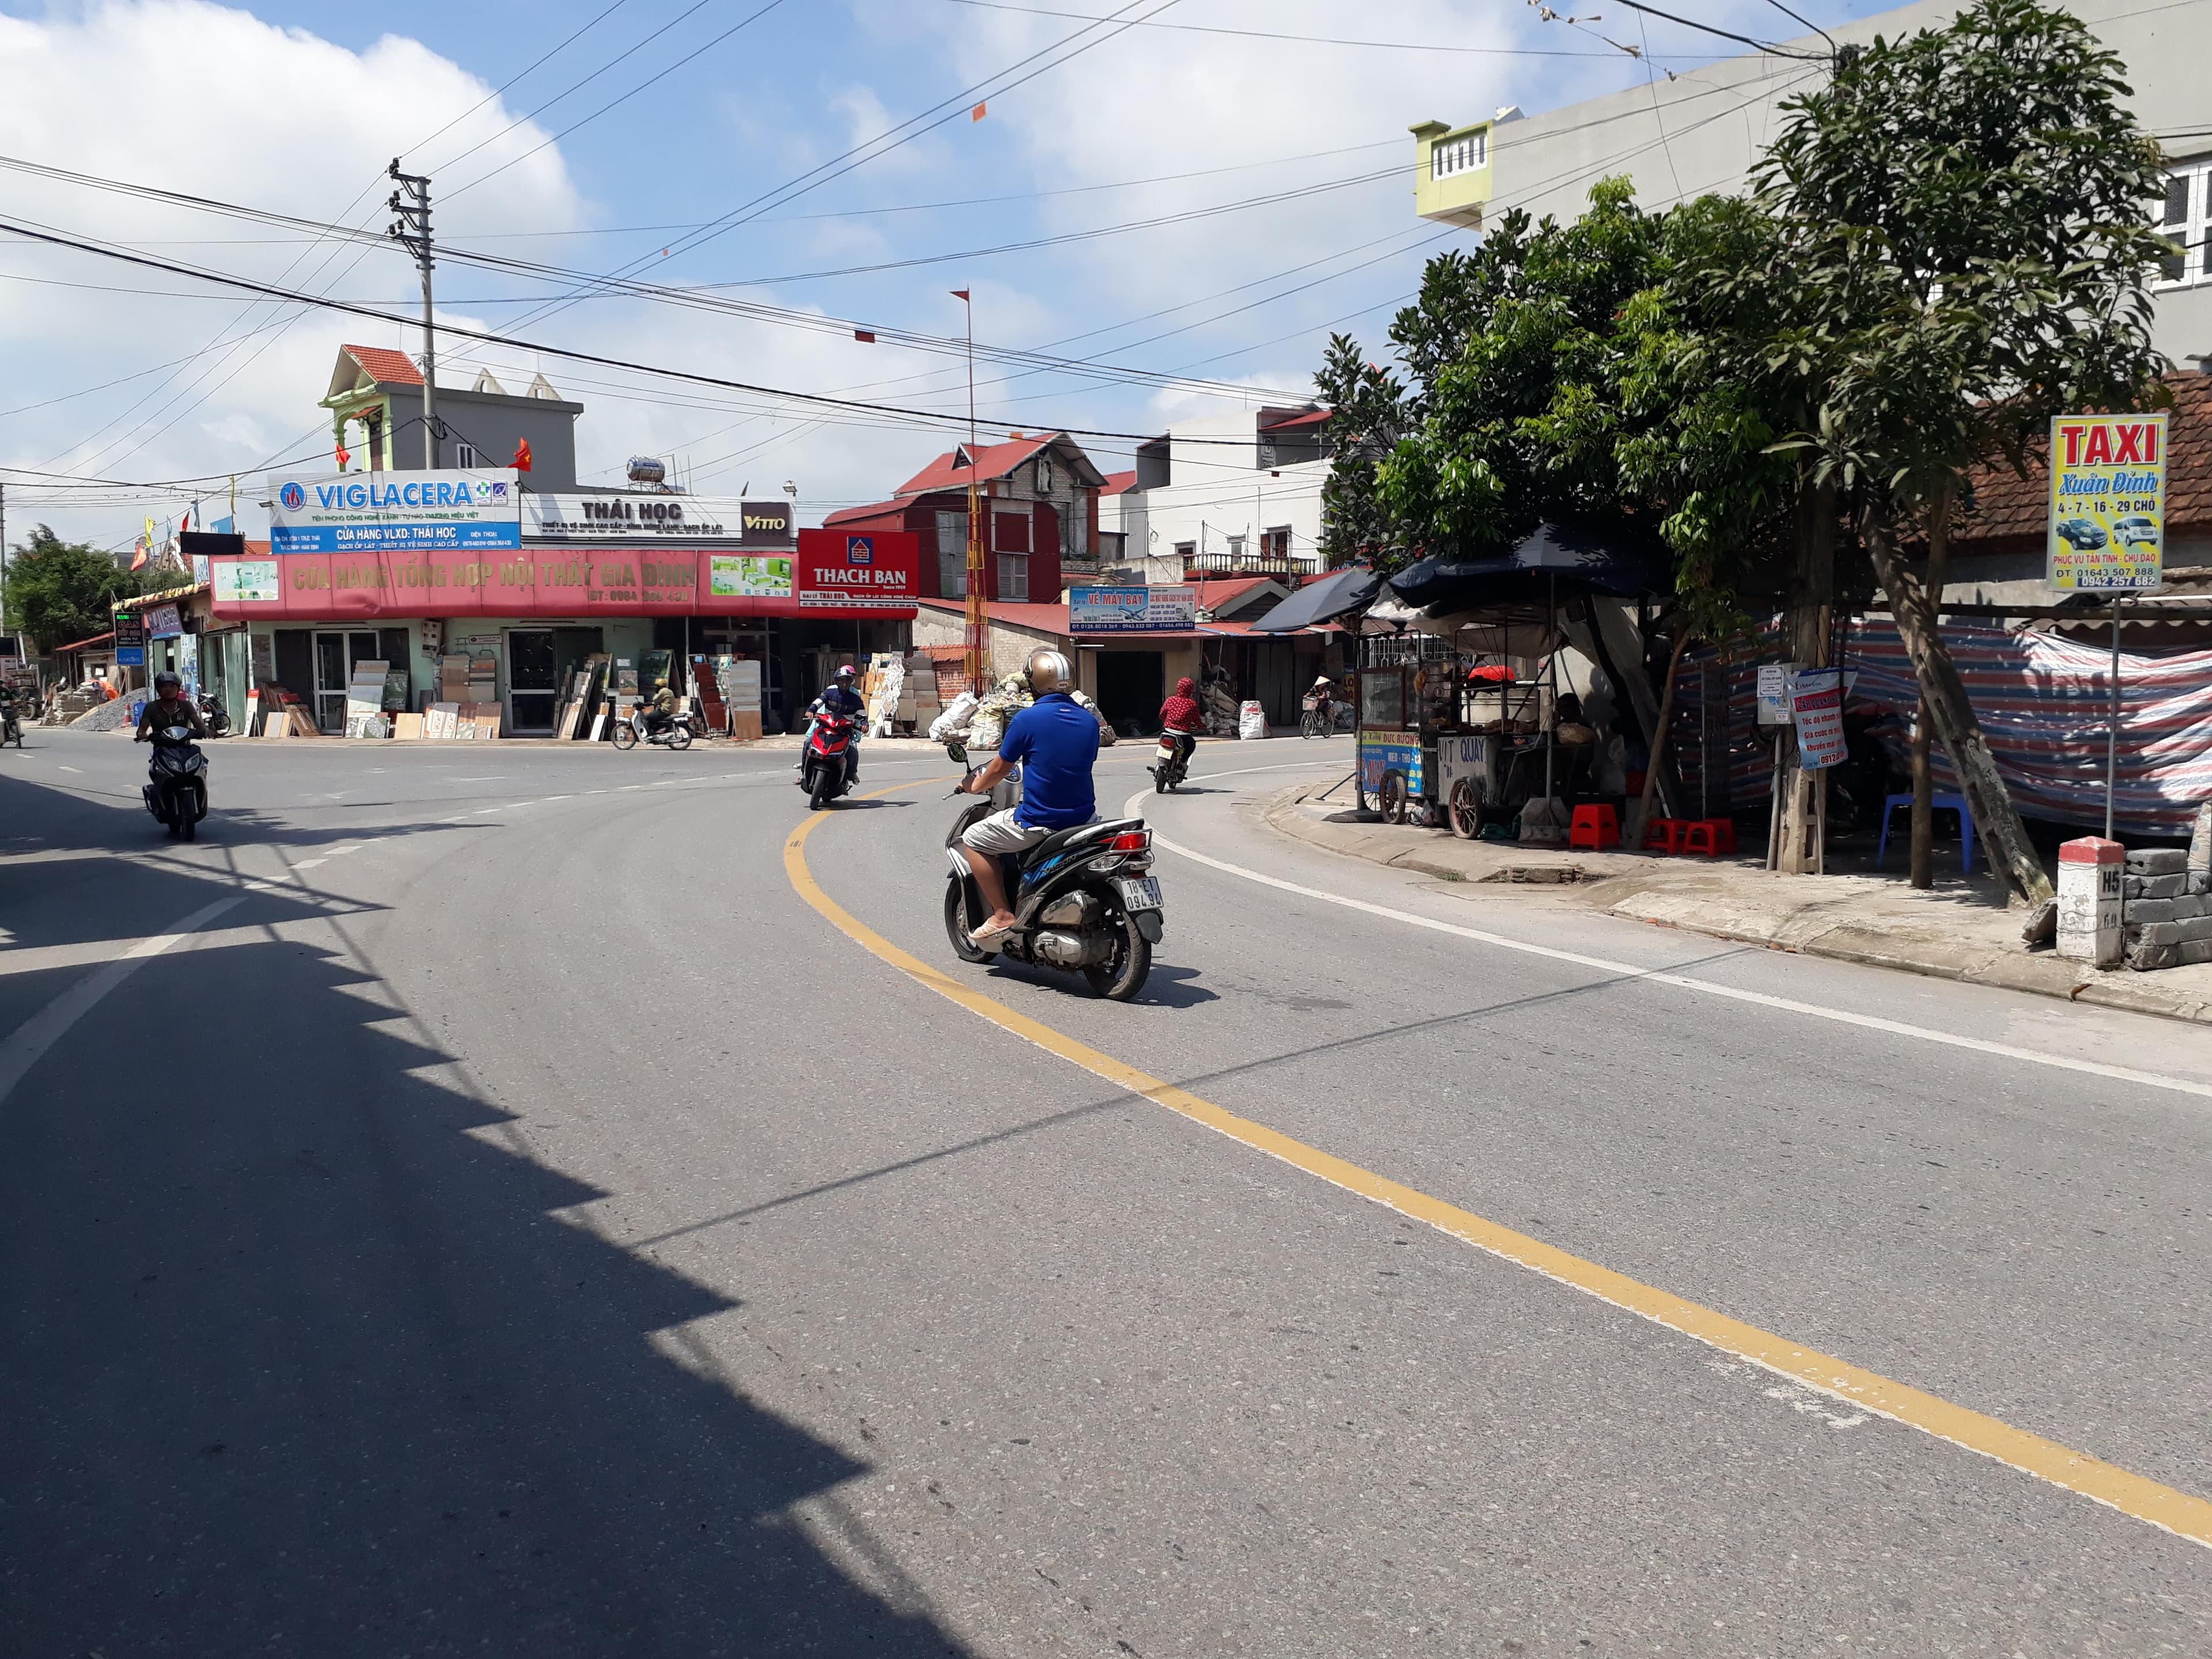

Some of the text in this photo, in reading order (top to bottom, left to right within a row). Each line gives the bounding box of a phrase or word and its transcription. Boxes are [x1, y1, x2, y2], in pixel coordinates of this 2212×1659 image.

[2060, 423, 2158, 466] TAXI
[2059, 470, 2157, 495] Xuân Đỉnh
[315, 482, 474, 509] VIGLACERA
[2058, 495, 2155, 513] 4 7 16 29 CHỖ
[581, 498, 682, 523] THÁI HỌC
[336, 525, 456, 540] CỬA HÀNG VLXD: THÁI HỌC
[336, 560, 389, 589] HÀNG
[394, 555, 447, 588] TỔNG
[452, 562, 494, 593] HỢP
[499, 556, 535, 592] NỘI
[540, 554, 594, 586] THẤT
[600, 562, 637, 586] GIA
[642, 558, 695, 588] ĐÌNH
[813, 568, 906, 584] THACH BAN
[2082, 577, 2155, 586] 0942 257 682
[1102, 591, 1124, 605] MÁY
[1126, 594, 1143, 605] BAY
[1460, 738, 1485, 763] QUAY
[1127, 879, 1154, 894] 18-E1
[2103, 870, 2120, 893] H5
[1127, 892, 1161, 909] 094.94
